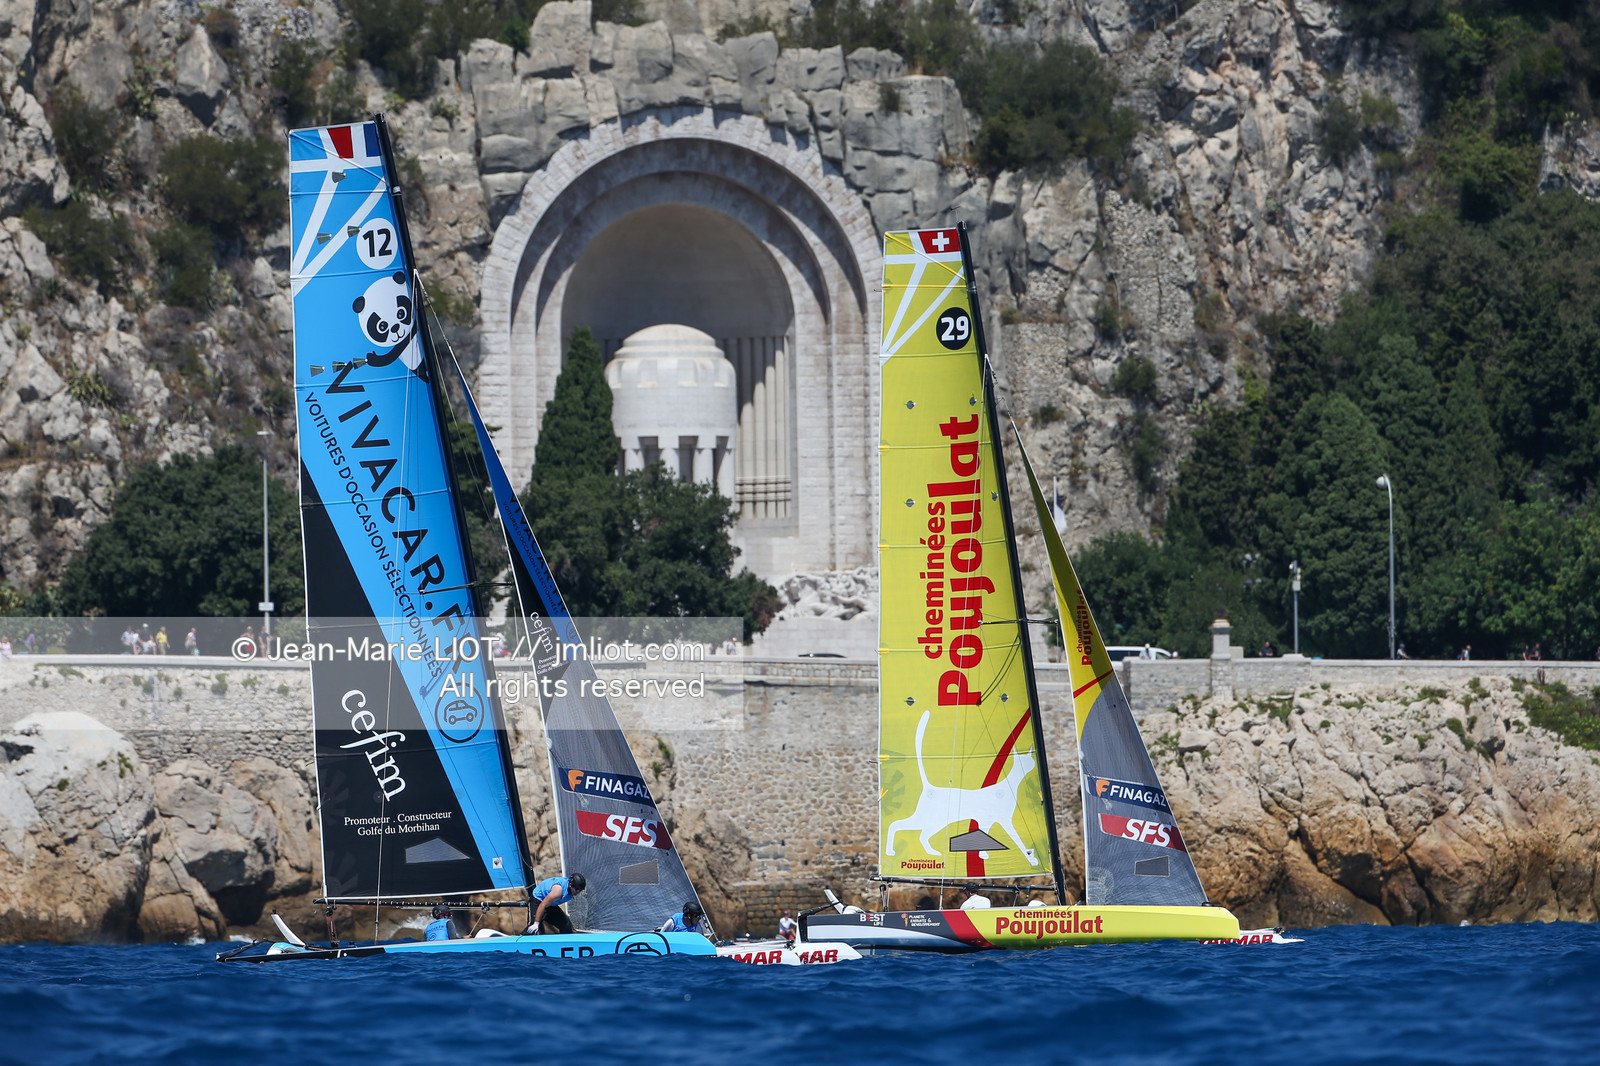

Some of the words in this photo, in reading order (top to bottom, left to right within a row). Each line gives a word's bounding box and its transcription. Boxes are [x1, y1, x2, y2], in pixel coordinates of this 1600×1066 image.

[362, 228, 393, 258] 12
[941, 315, 969, 342] 29
[304, 391, 346, 467] VOITURES
[338, 465, 390, 561] D'OCCASION
[325, 360, 476, 674] VIVACAR.FR
[926, 413, 996, 706] Poujoulat
[917, 501, 946, 659] cheminées
[340, 689, 406, 802] cefim
[585, 775, 650, 800] FINAGAZ
[1109, 784, 1167, 807] FINAGAZ
[344, 815, 390, 826] Promoteur
[397, 811, 452, 823] Constructeur
[357, 825, 382, 836] Golfe
[385, 825, 396, 835] du
[398, 822, 440, 834] Morbihan
[601, 814, 658, 848] SFS
[1121, 819, 1172, 847] SFS
[995, 911, 1104, 940] Poujoulat
[1013, 908, 1073, 919] cheminées
